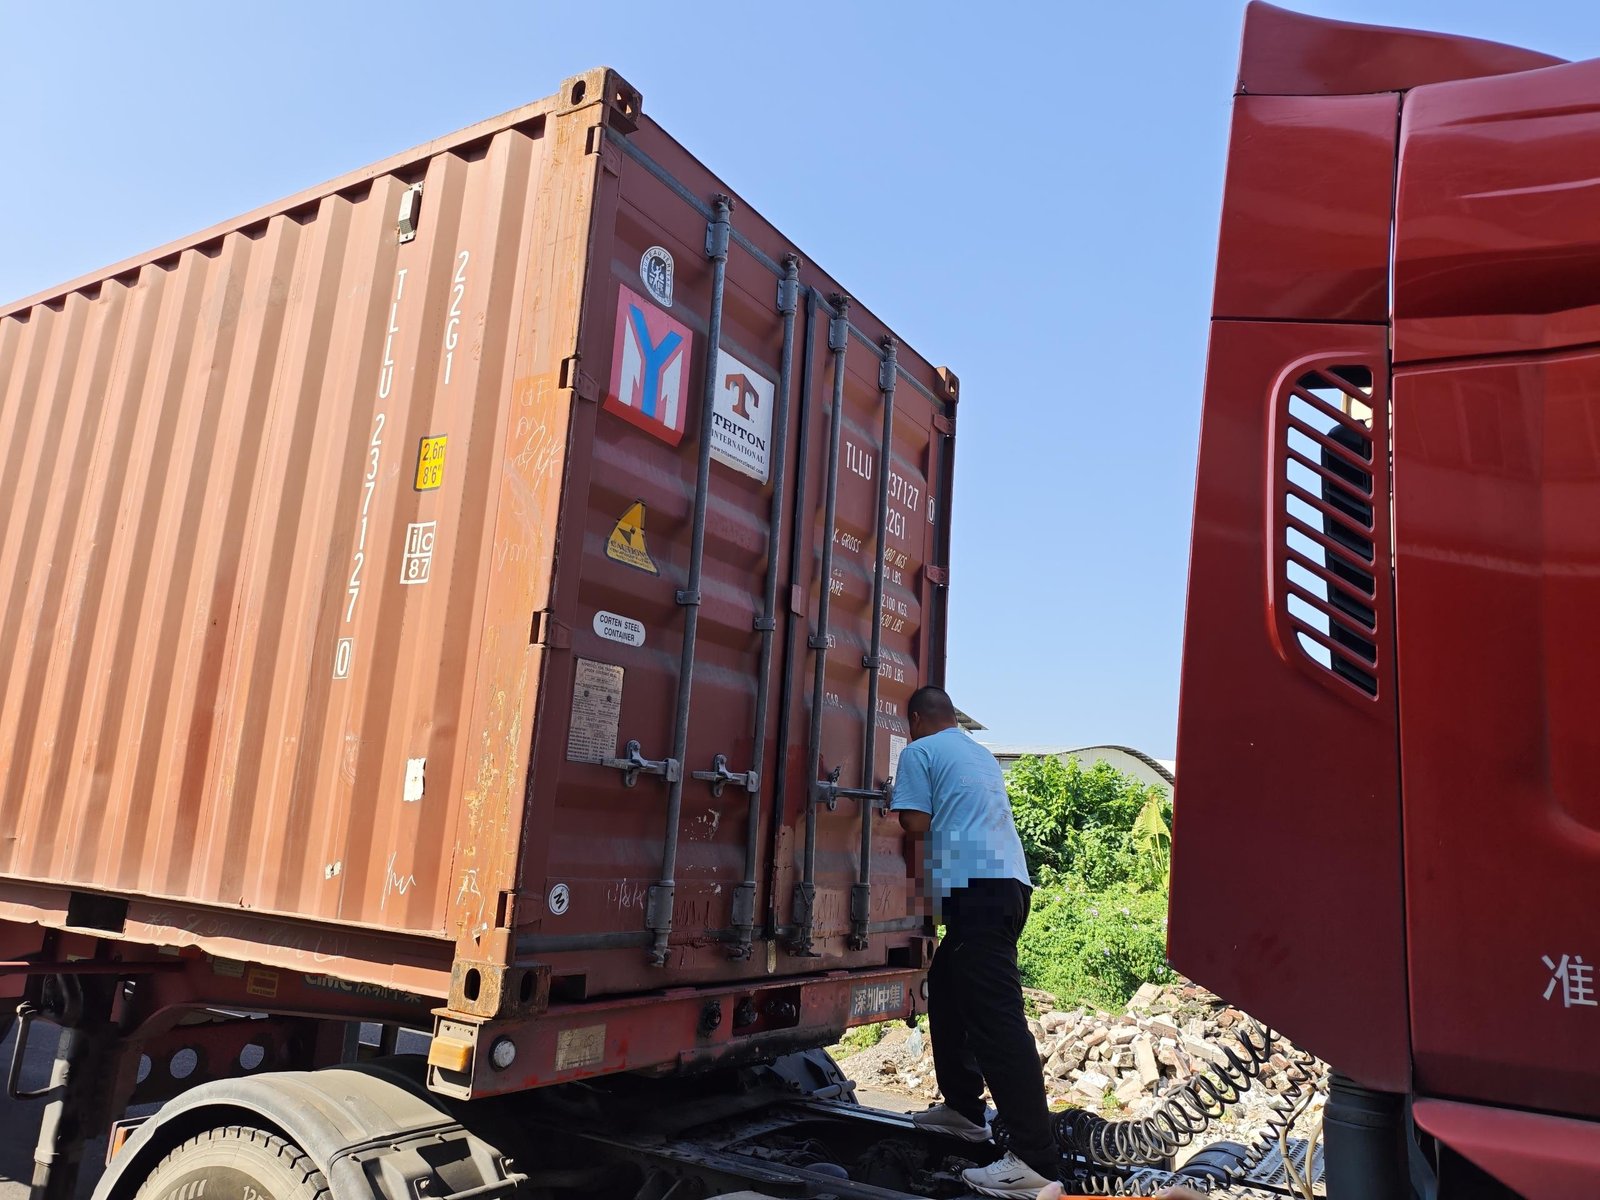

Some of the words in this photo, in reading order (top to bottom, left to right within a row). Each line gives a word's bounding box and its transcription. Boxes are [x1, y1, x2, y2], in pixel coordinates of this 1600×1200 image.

[378, 269, 407, 399] TLLU
[445, 250, 470, 385] 22G1
[711, 428, 765, 465] INTERNATIONAL
[712, 411, 766, 452] TRITON
[845, 441, 873, 481] TLLU
[346, 413, 385, 623] 237127
[841, 532, 862, 553] GROSS
[408, 558, 430, 579] 87
[600, 614, 622, 627] CORTEN
[624, 621, 641, 633] STEEL
[603, 627, 635, 642] CONTAINER
[880, 611, 892, 628] 630
[1541, 953, 1598, 1008] 准
[854, 984, 901, 1015] 深圳中集
